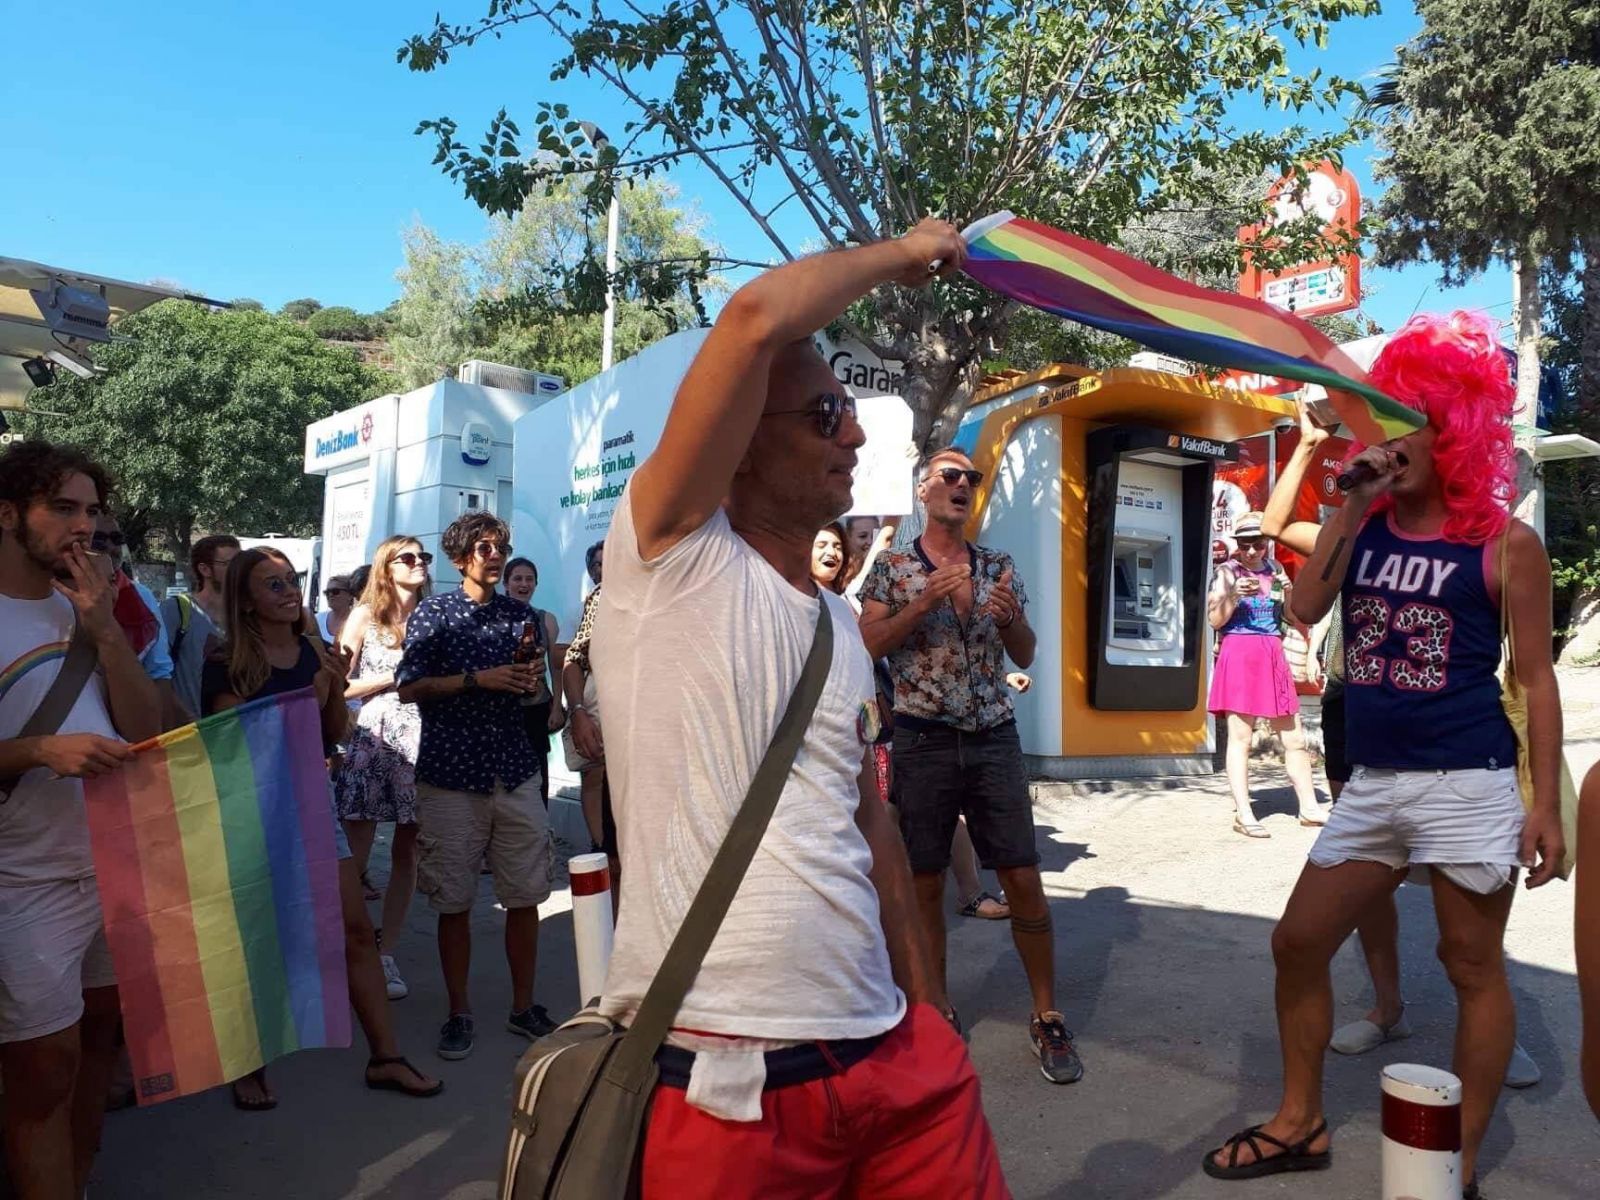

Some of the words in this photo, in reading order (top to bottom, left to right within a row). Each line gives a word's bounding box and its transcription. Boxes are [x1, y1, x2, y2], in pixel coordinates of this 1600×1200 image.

[829, 350, 902, 397] Garan
[1218, 373, 1279, 393] ANK
[560, 495, 570, 508] ve
[570, 489, 591, 507] kolay
[1355, 549, 1459, 597] LADY
[1347, 595, 1454, 693] 23
